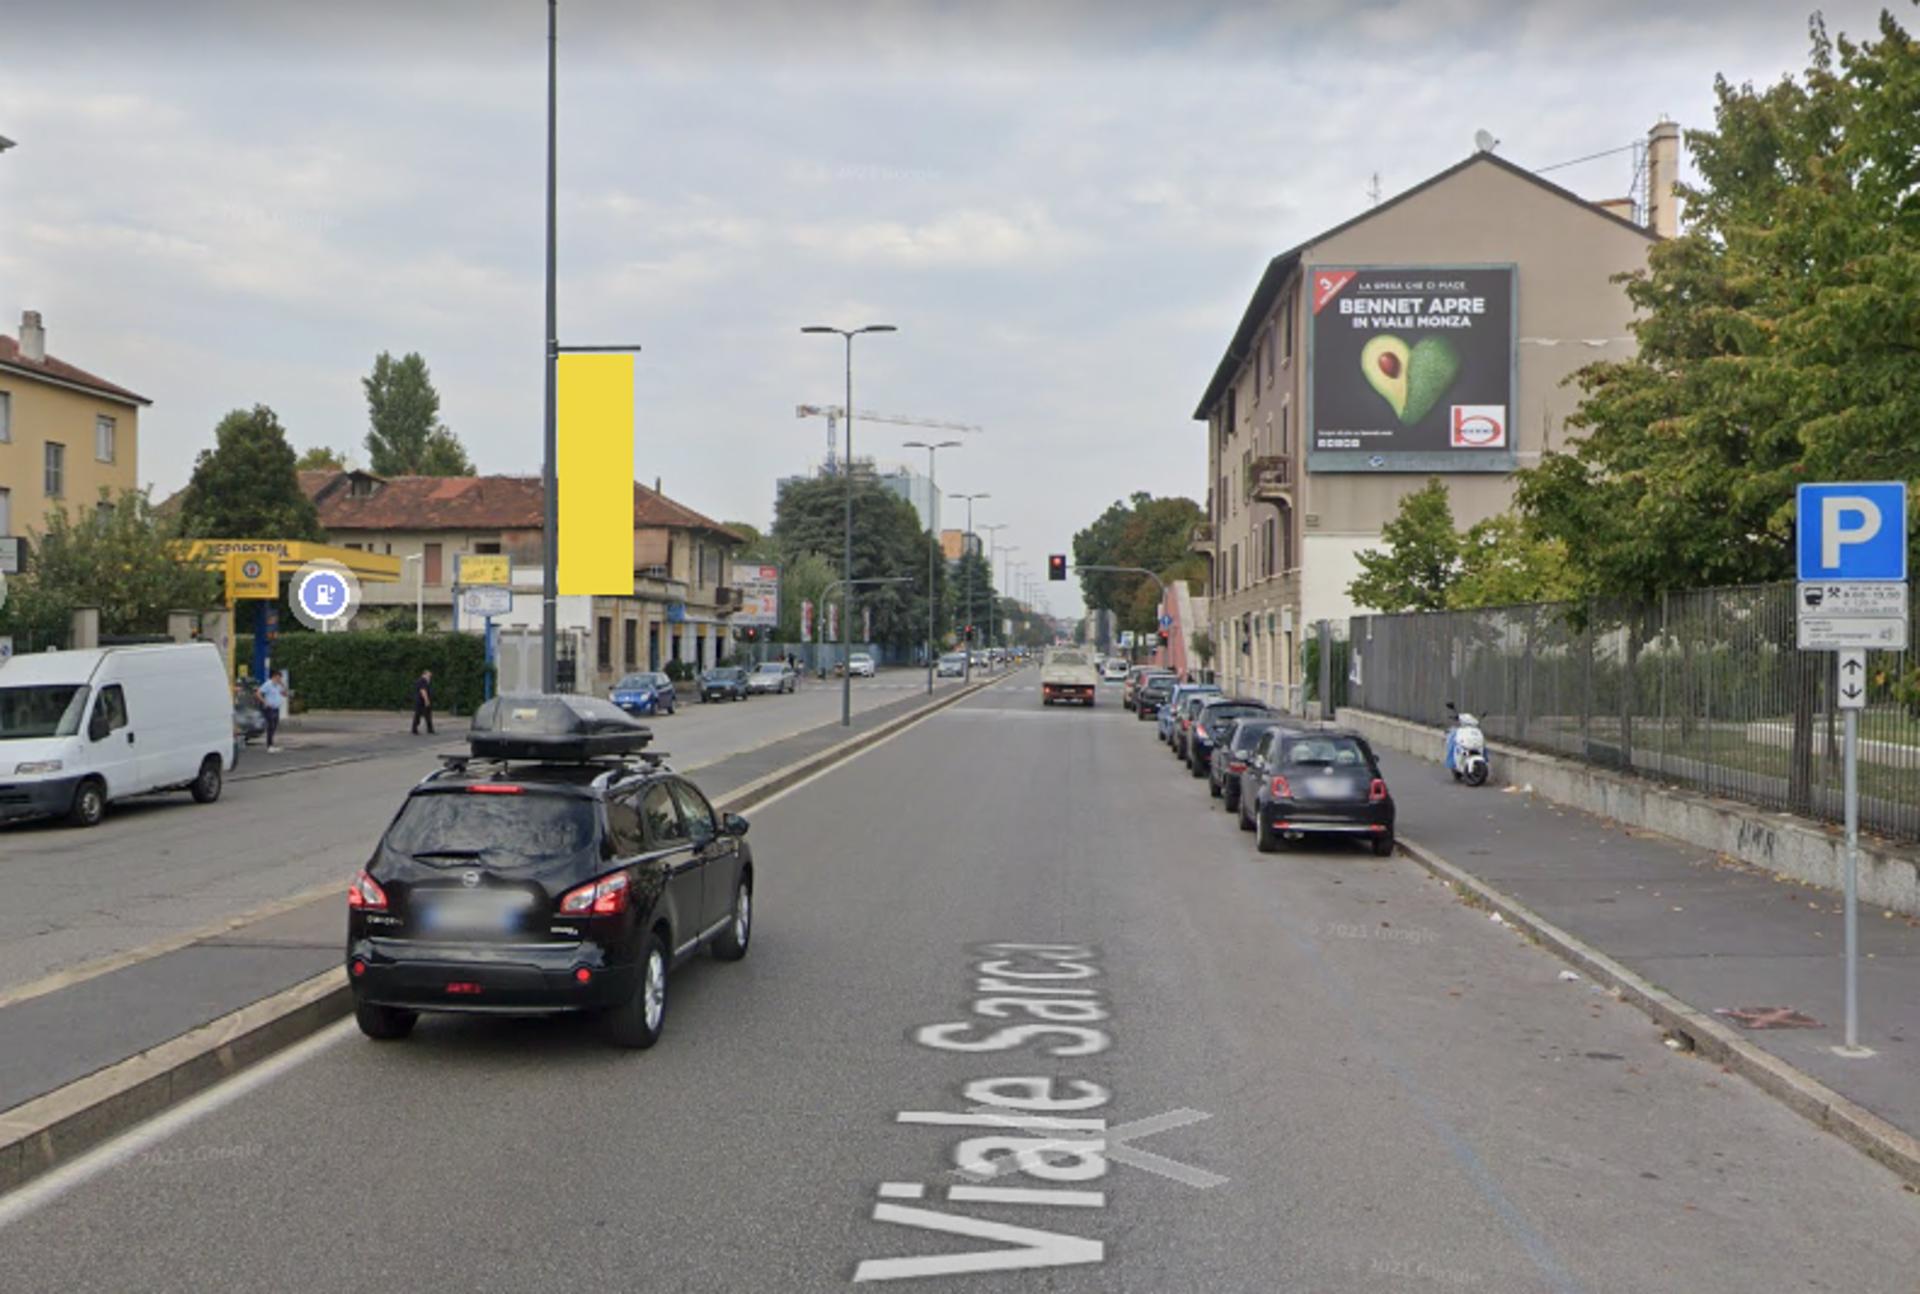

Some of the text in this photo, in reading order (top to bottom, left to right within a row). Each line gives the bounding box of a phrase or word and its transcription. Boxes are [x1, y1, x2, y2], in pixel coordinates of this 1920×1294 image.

[1359, 281, 1371, 290] LA
[1339, 298, 1486, 315] BENNET APRE
[1353, 315, 1472, 328] IN VIALE MONZA
[1822, 497, 1882, 569] P
